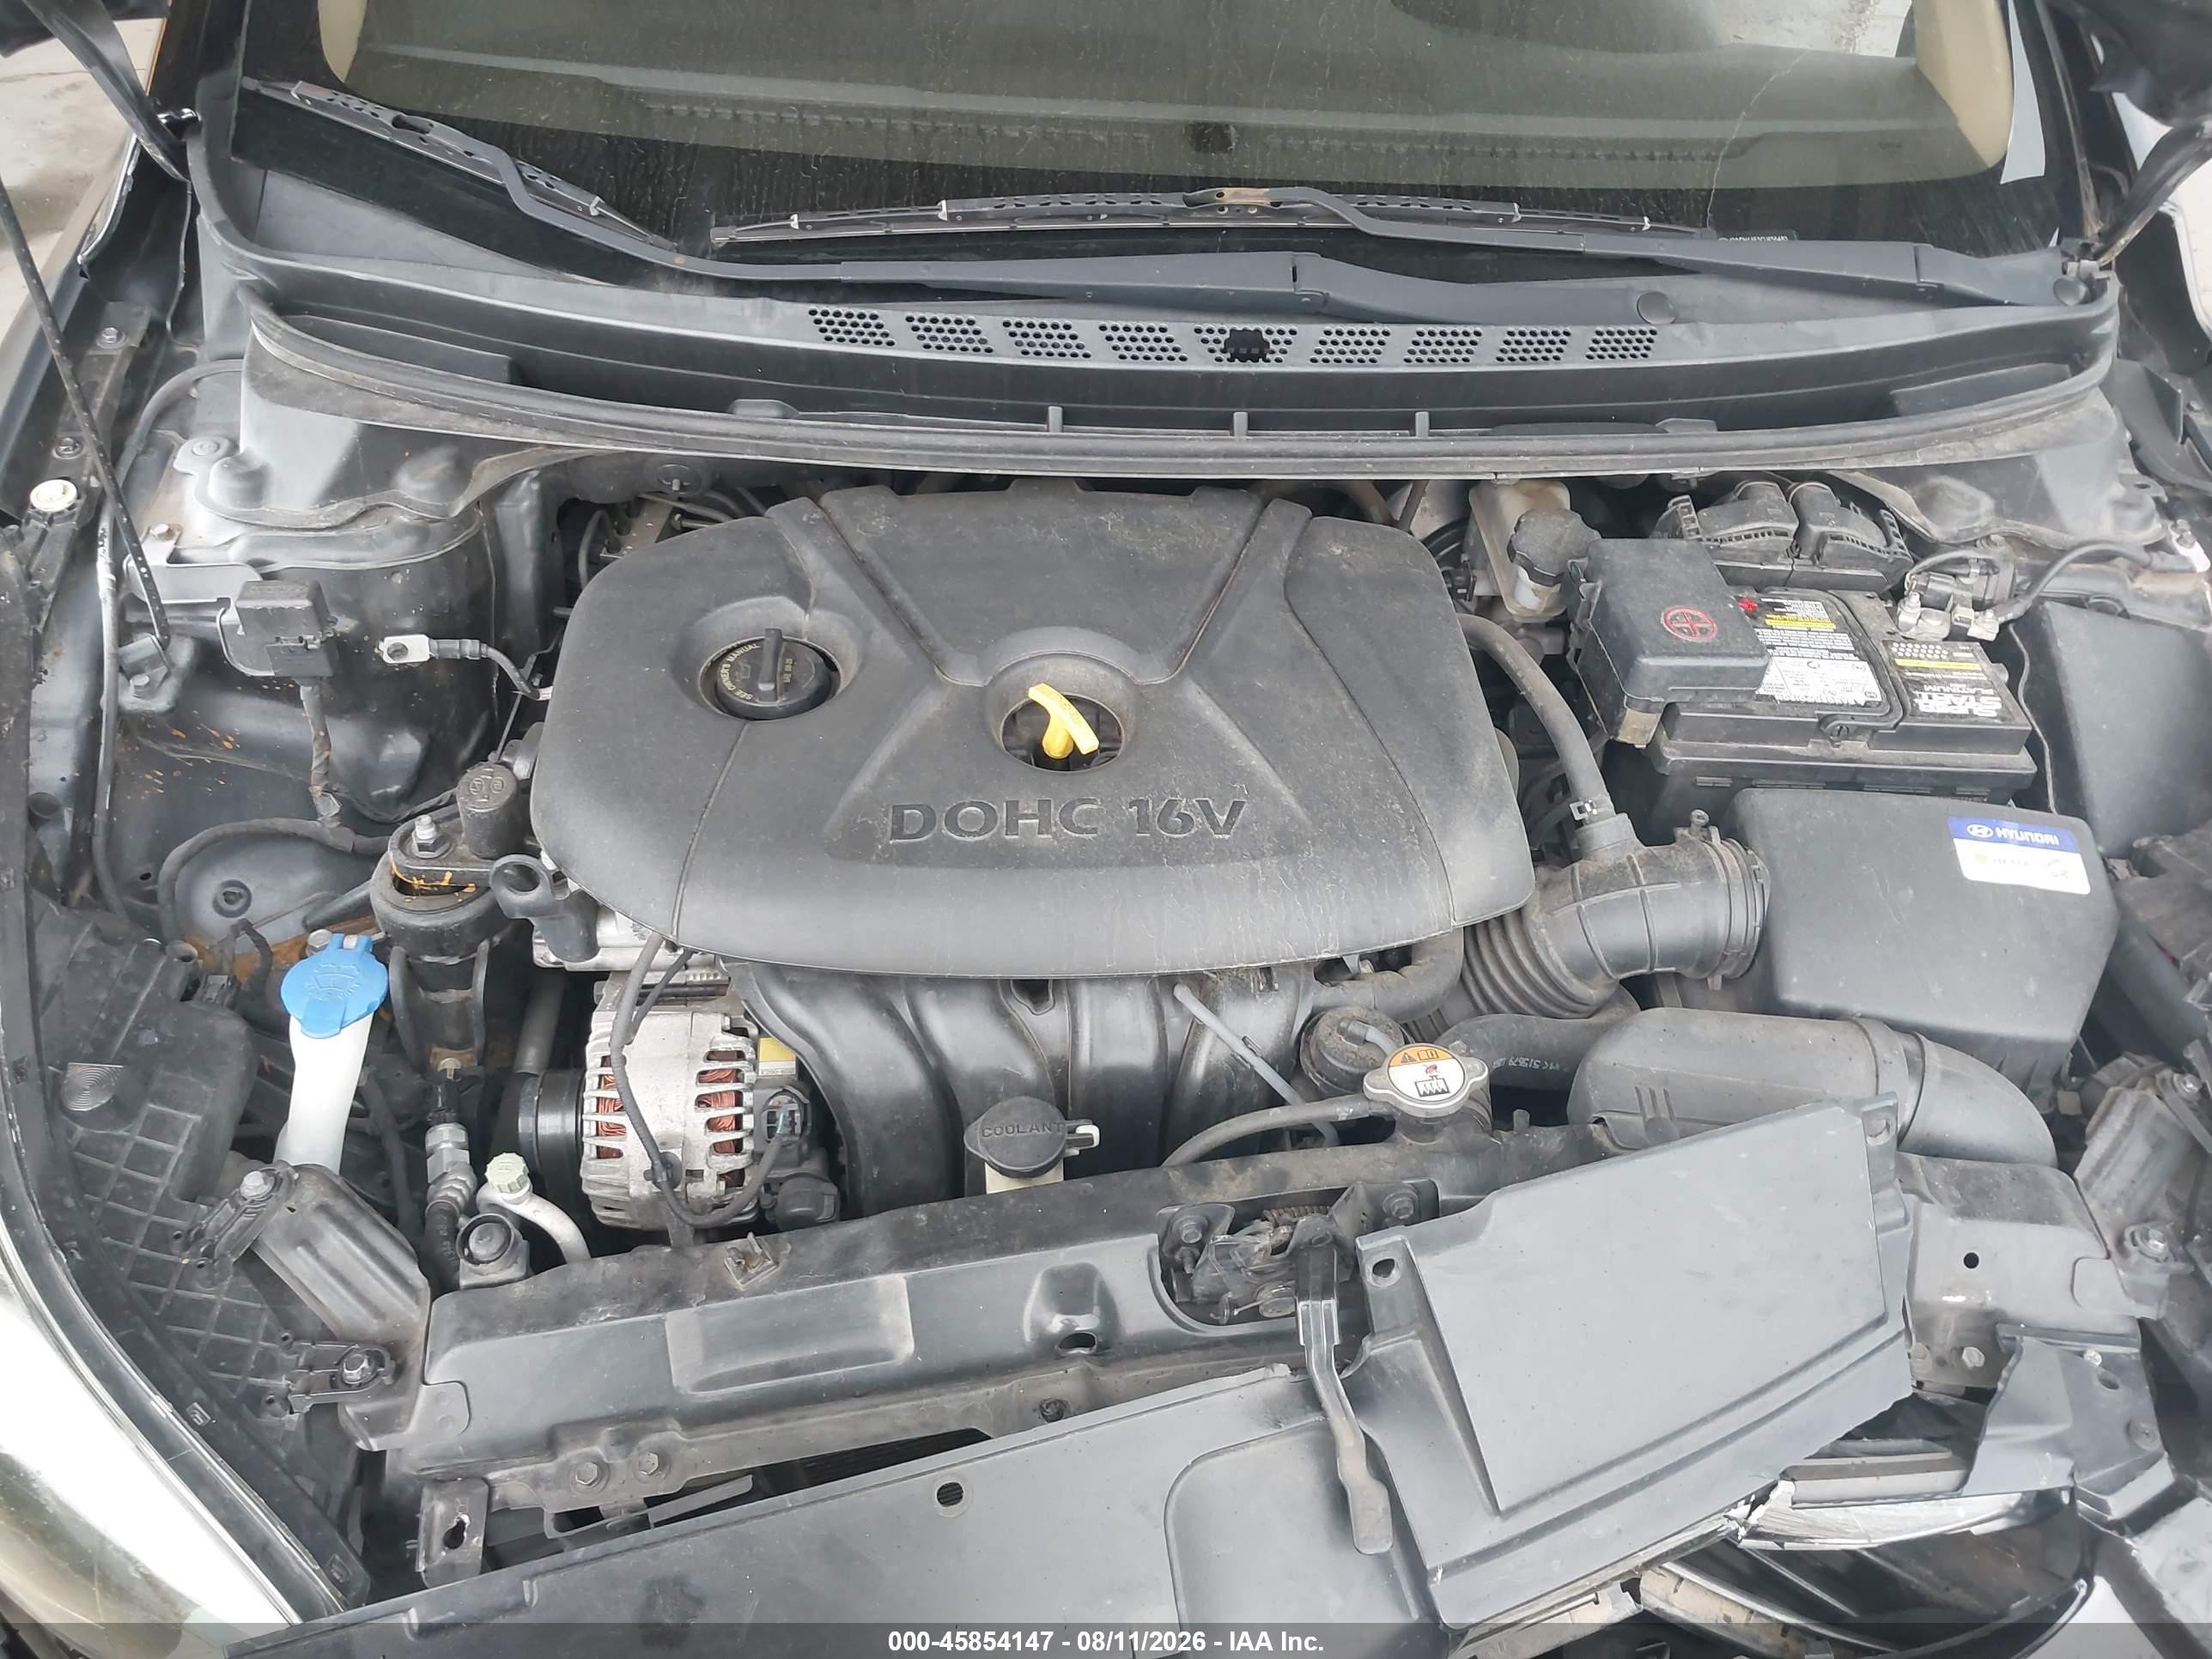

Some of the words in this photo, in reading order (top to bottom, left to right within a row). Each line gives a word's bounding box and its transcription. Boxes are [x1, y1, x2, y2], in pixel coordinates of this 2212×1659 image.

[726, 642, 762, 662] MANUAL
[733, 689, 754, 701] SEE
[1923, 684, 1996, 696] PLATINUM
[890, 798, 1106, 843] DOHC
[1128, 798, 1248, 840] 16V
[1995, 826, 2060, 846] HYUNDAI
[981, 1121, 1066, 1138] COOLANT
